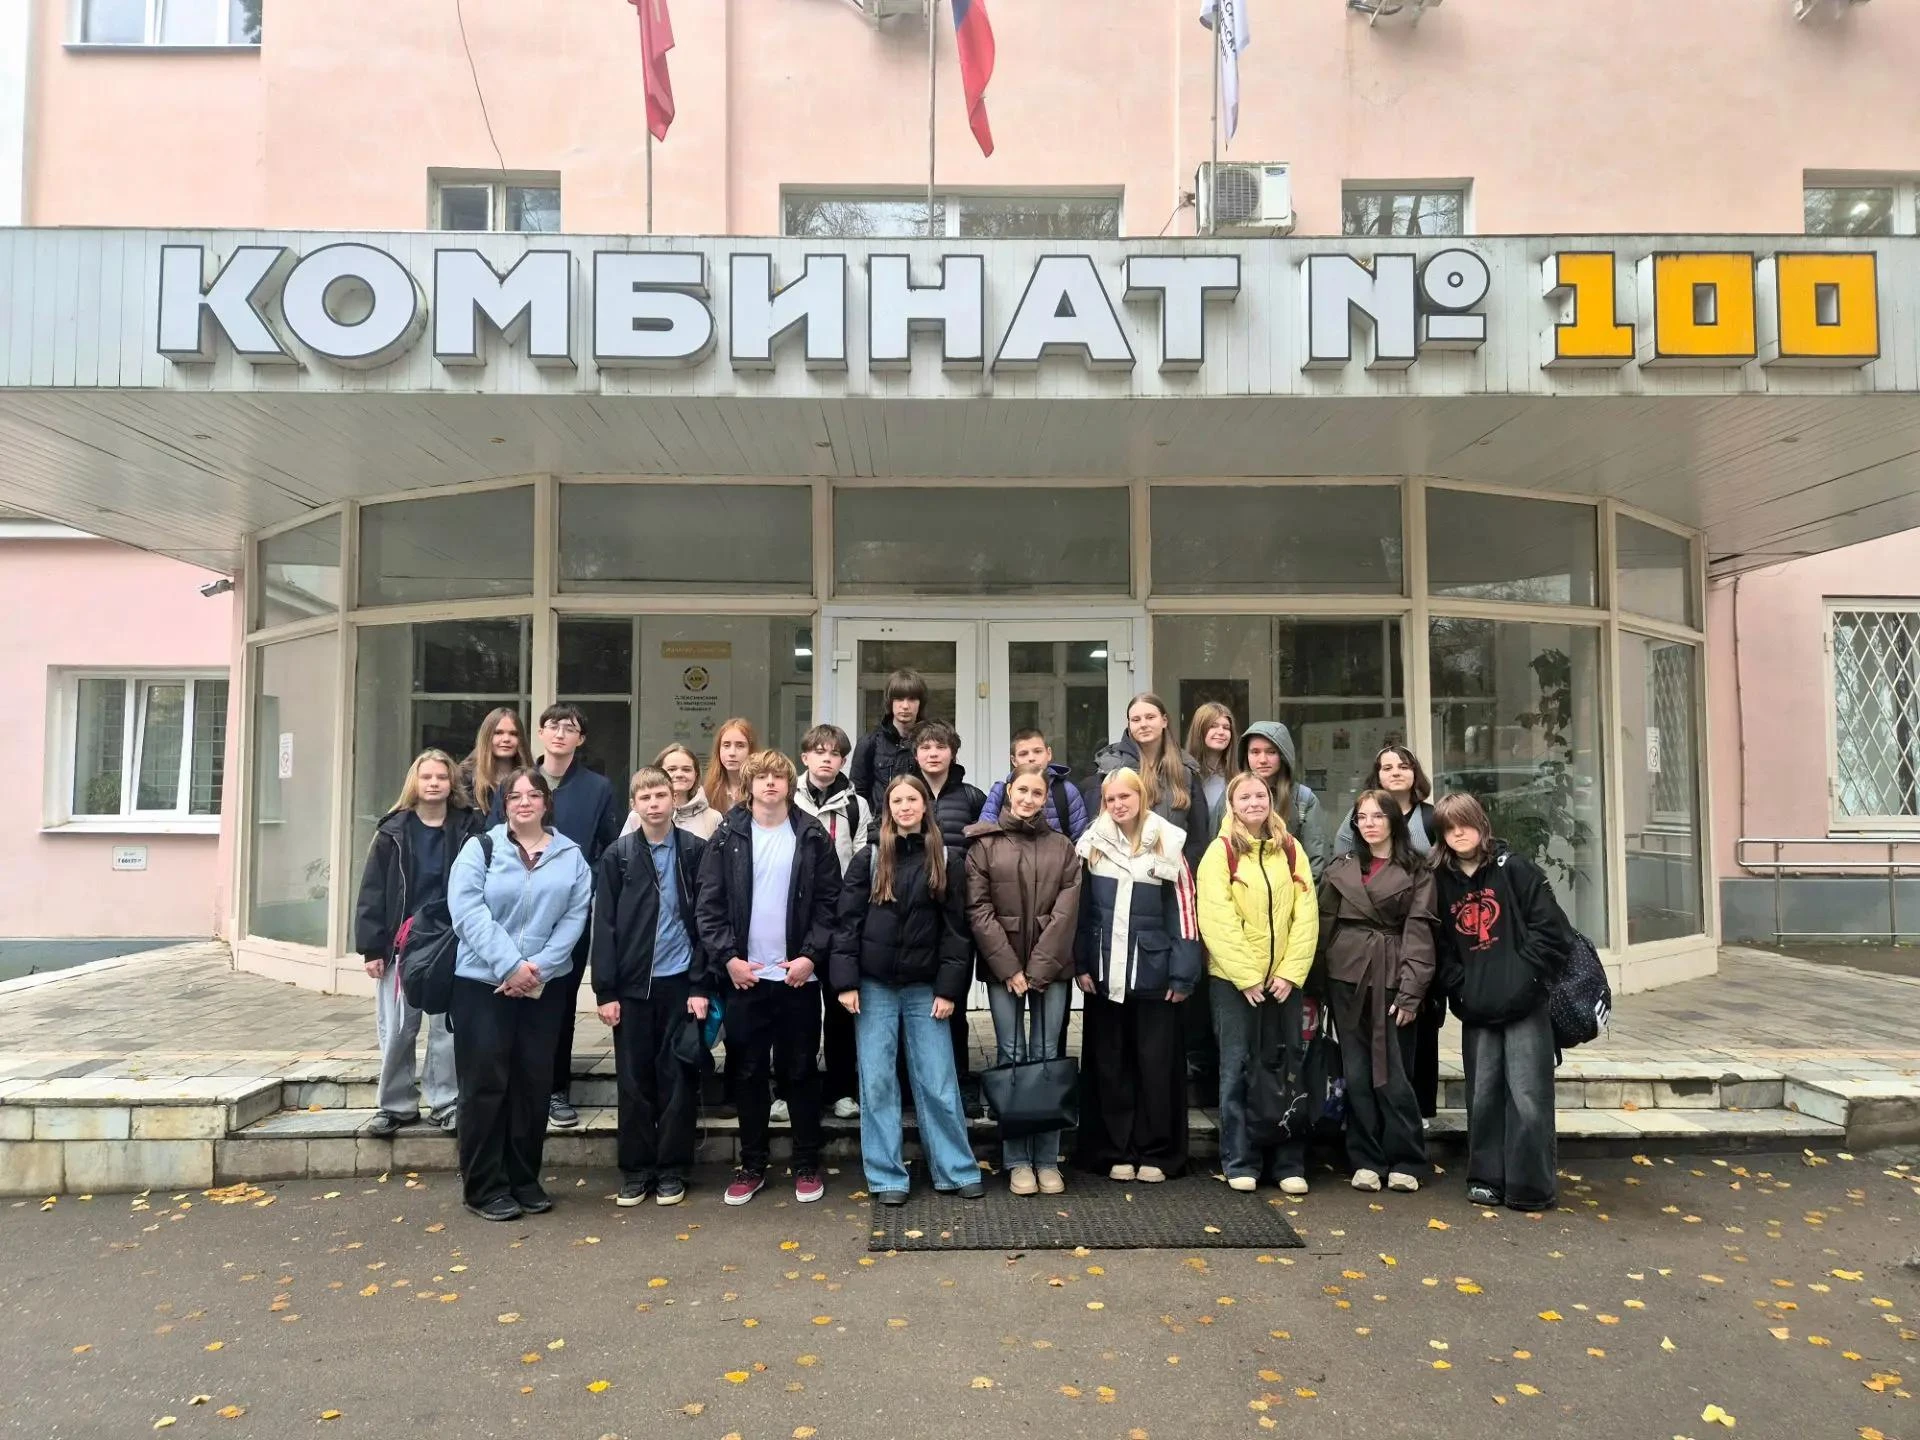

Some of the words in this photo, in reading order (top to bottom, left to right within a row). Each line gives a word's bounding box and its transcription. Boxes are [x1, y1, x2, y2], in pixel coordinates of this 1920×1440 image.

[157, 242, 1241, 366] КОМБИНАТ
[1304, 248, 1491, 364] №
[1550, 250, 1881, 364] 100
